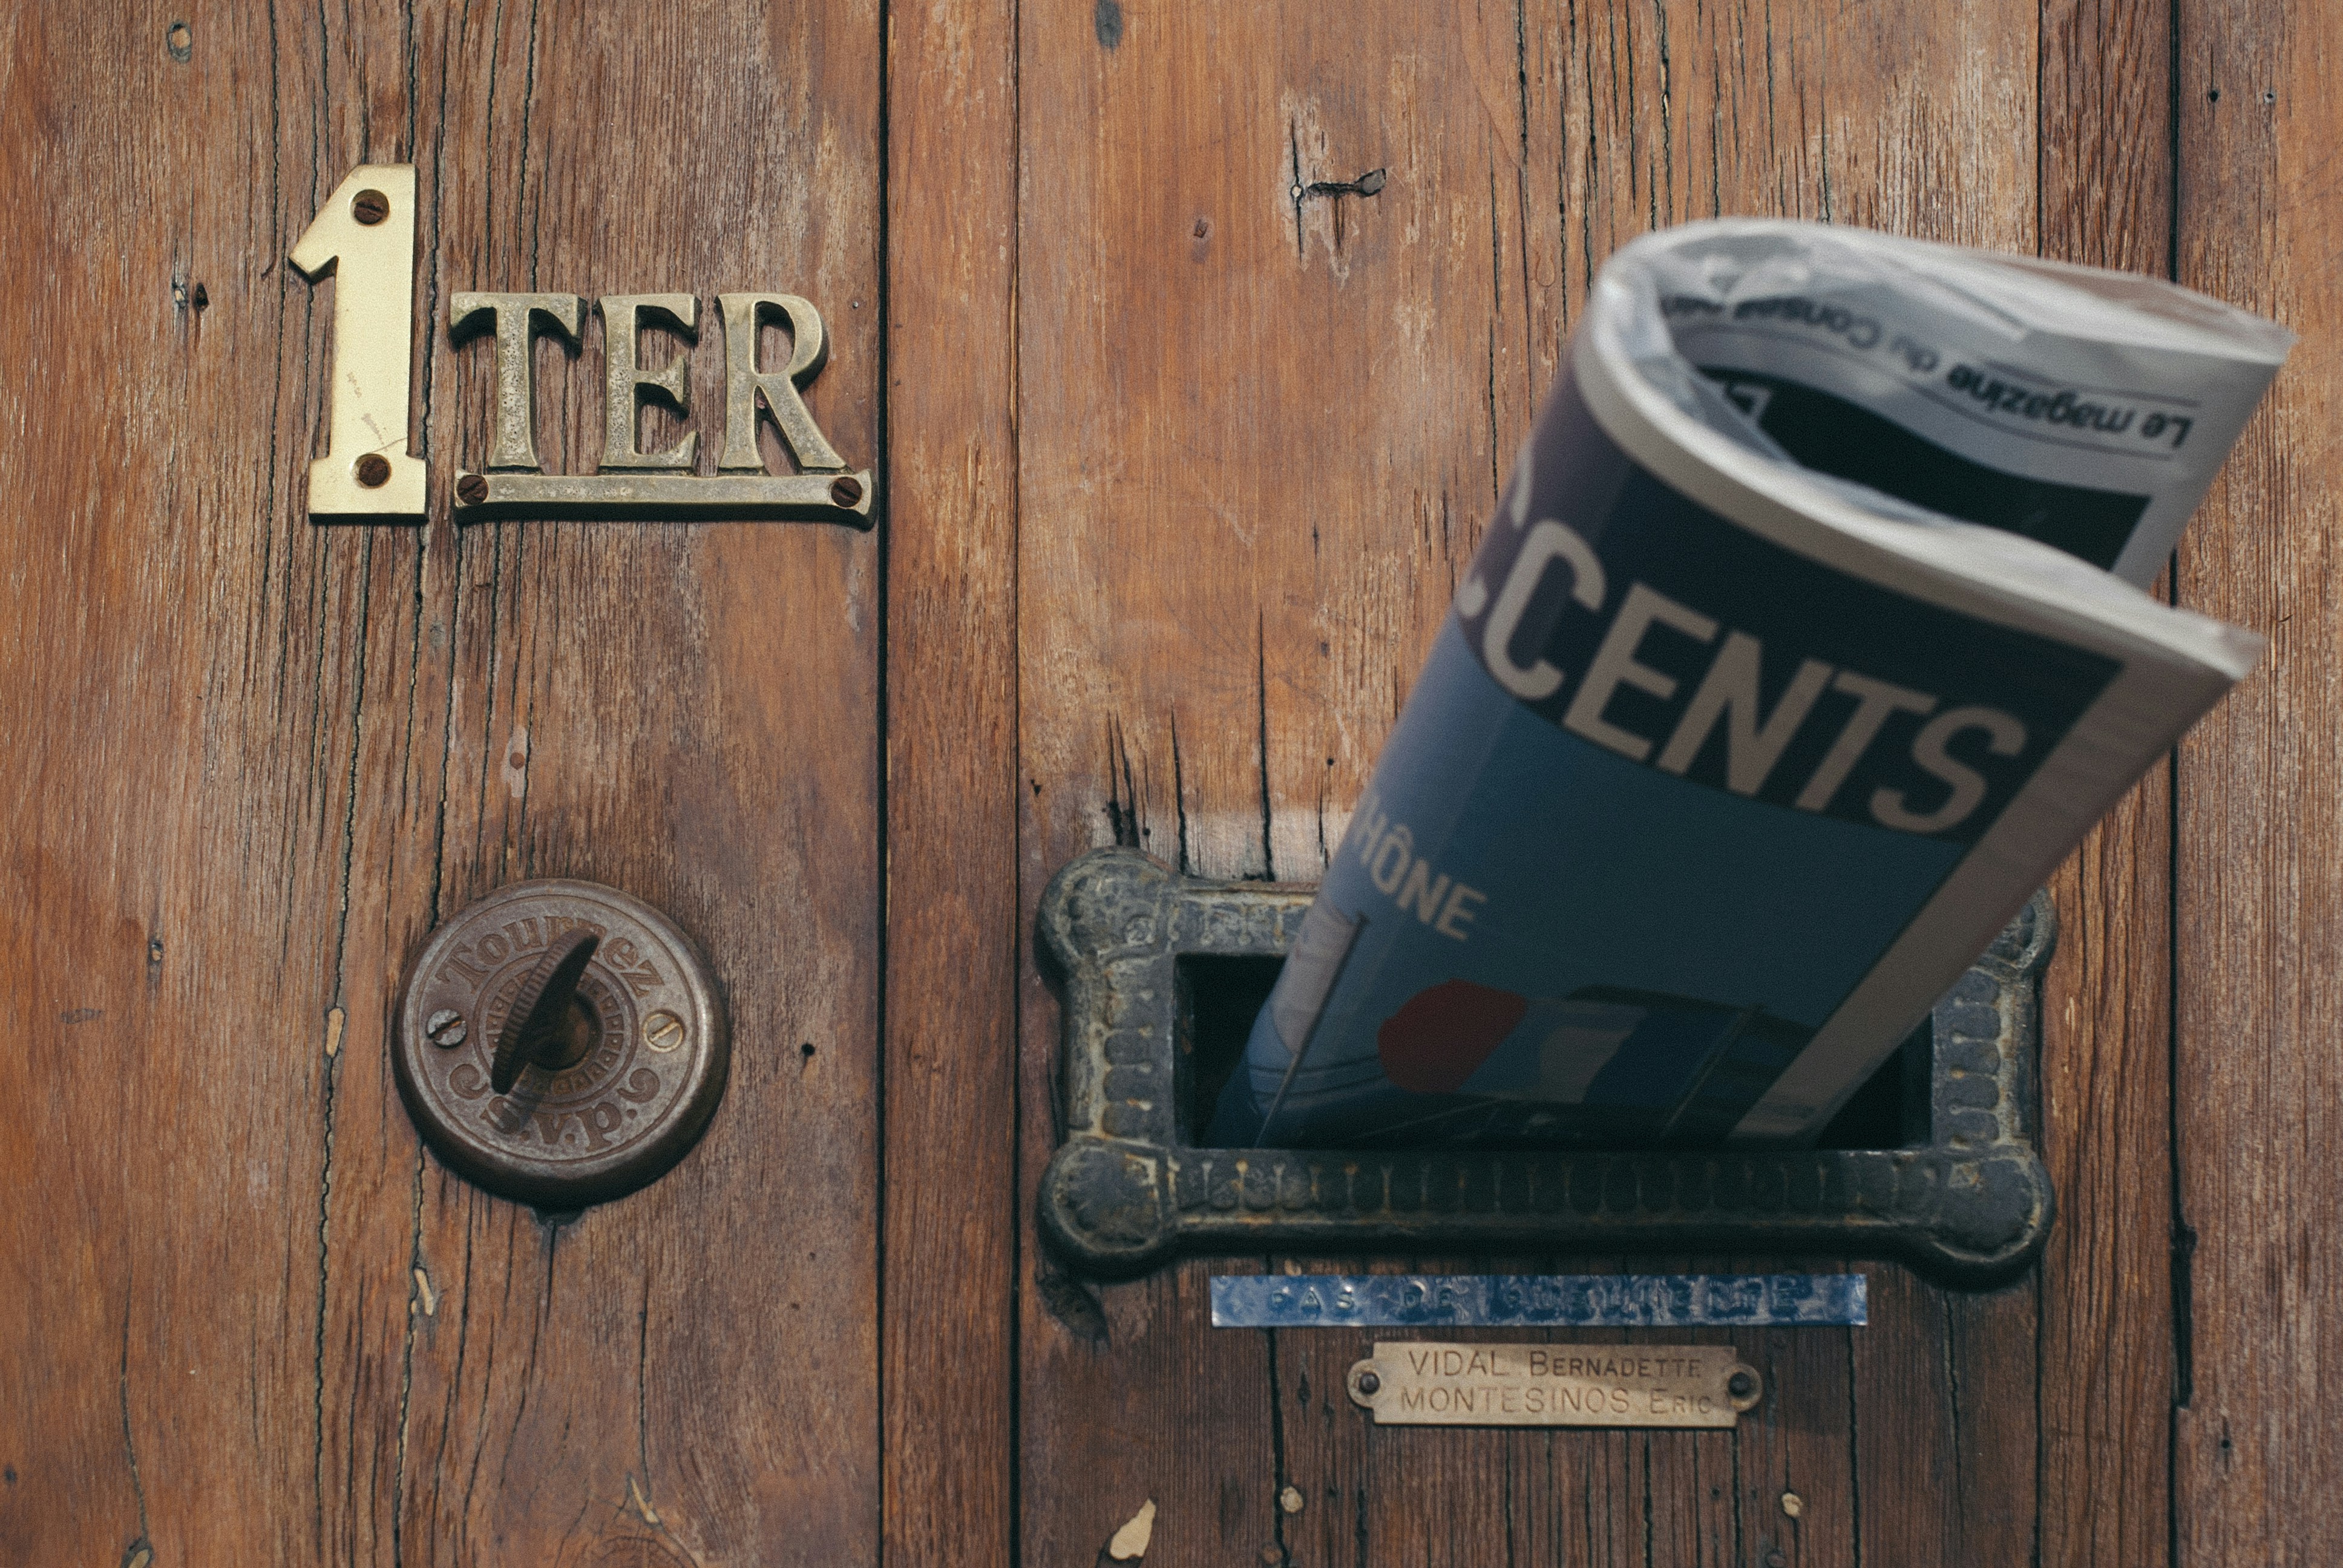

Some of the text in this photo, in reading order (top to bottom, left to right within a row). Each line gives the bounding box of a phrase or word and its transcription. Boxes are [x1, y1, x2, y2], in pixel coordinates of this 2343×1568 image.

[289, 163, 848, 524] 1 TER
[1947, 363, 2137, 434] magazine
[2140, 411, 2194, 449] Le
[1457, 448, 2028, 834] CENTS
[1409, 1350, 1510, 1377] VIDAL
[1401, 1387, 1630, 1413] MONTESINOS
